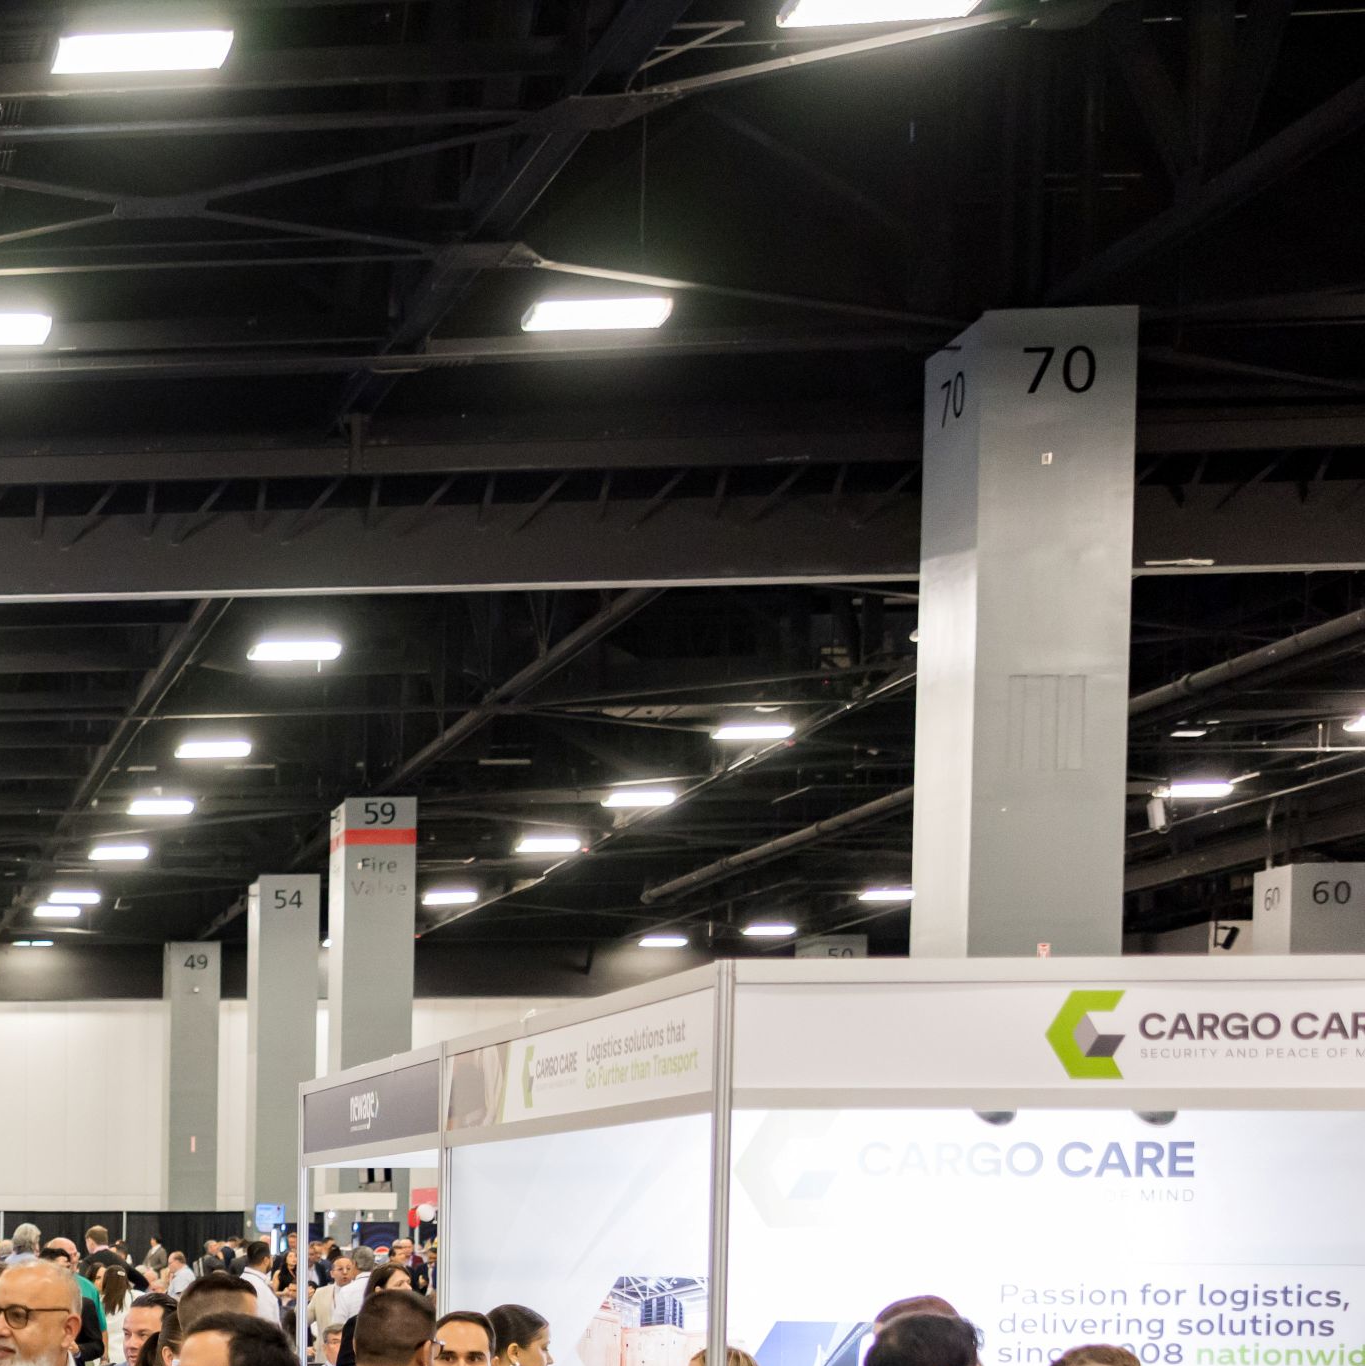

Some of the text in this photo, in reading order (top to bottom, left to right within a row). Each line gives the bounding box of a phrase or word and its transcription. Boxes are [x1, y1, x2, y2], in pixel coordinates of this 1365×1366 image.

[1024, 346, 1096, 394] 70
[941, 371, 965, 428] 70
[364, 802, 396, 825] 59
[361, 858, 397, 873] Fire
[274, 890, 303, 909] 54
[1313, 881, 1351, 904] 60
[184, 954, 208, 970] 49
[1139, 1012, 1281, 1040] CARGO
[586, 1019, 685, 1065] Logistics solutions that
[1140, 1048, 1218, 1059] SECURITY
[1225, 1048, 1258, 1059] AND
[1266, 1048, 1319, 1059] PEACE
[1326, 1048, 1349, 1059] OF
[535, 1051, 577, 1080] CARGO CARE
[653, 1049, 699, 1079] Transport
[858, 1141, 1195, 1178] CARGO CARE
[1140, 1188, 1194, 1202] MIND
[1001, 1283, 1350, 1312] Passion for logistics,
[999, 1313, 1335, 1339] delivering solutions
[998, 1341, 1062, 1364] sinc
